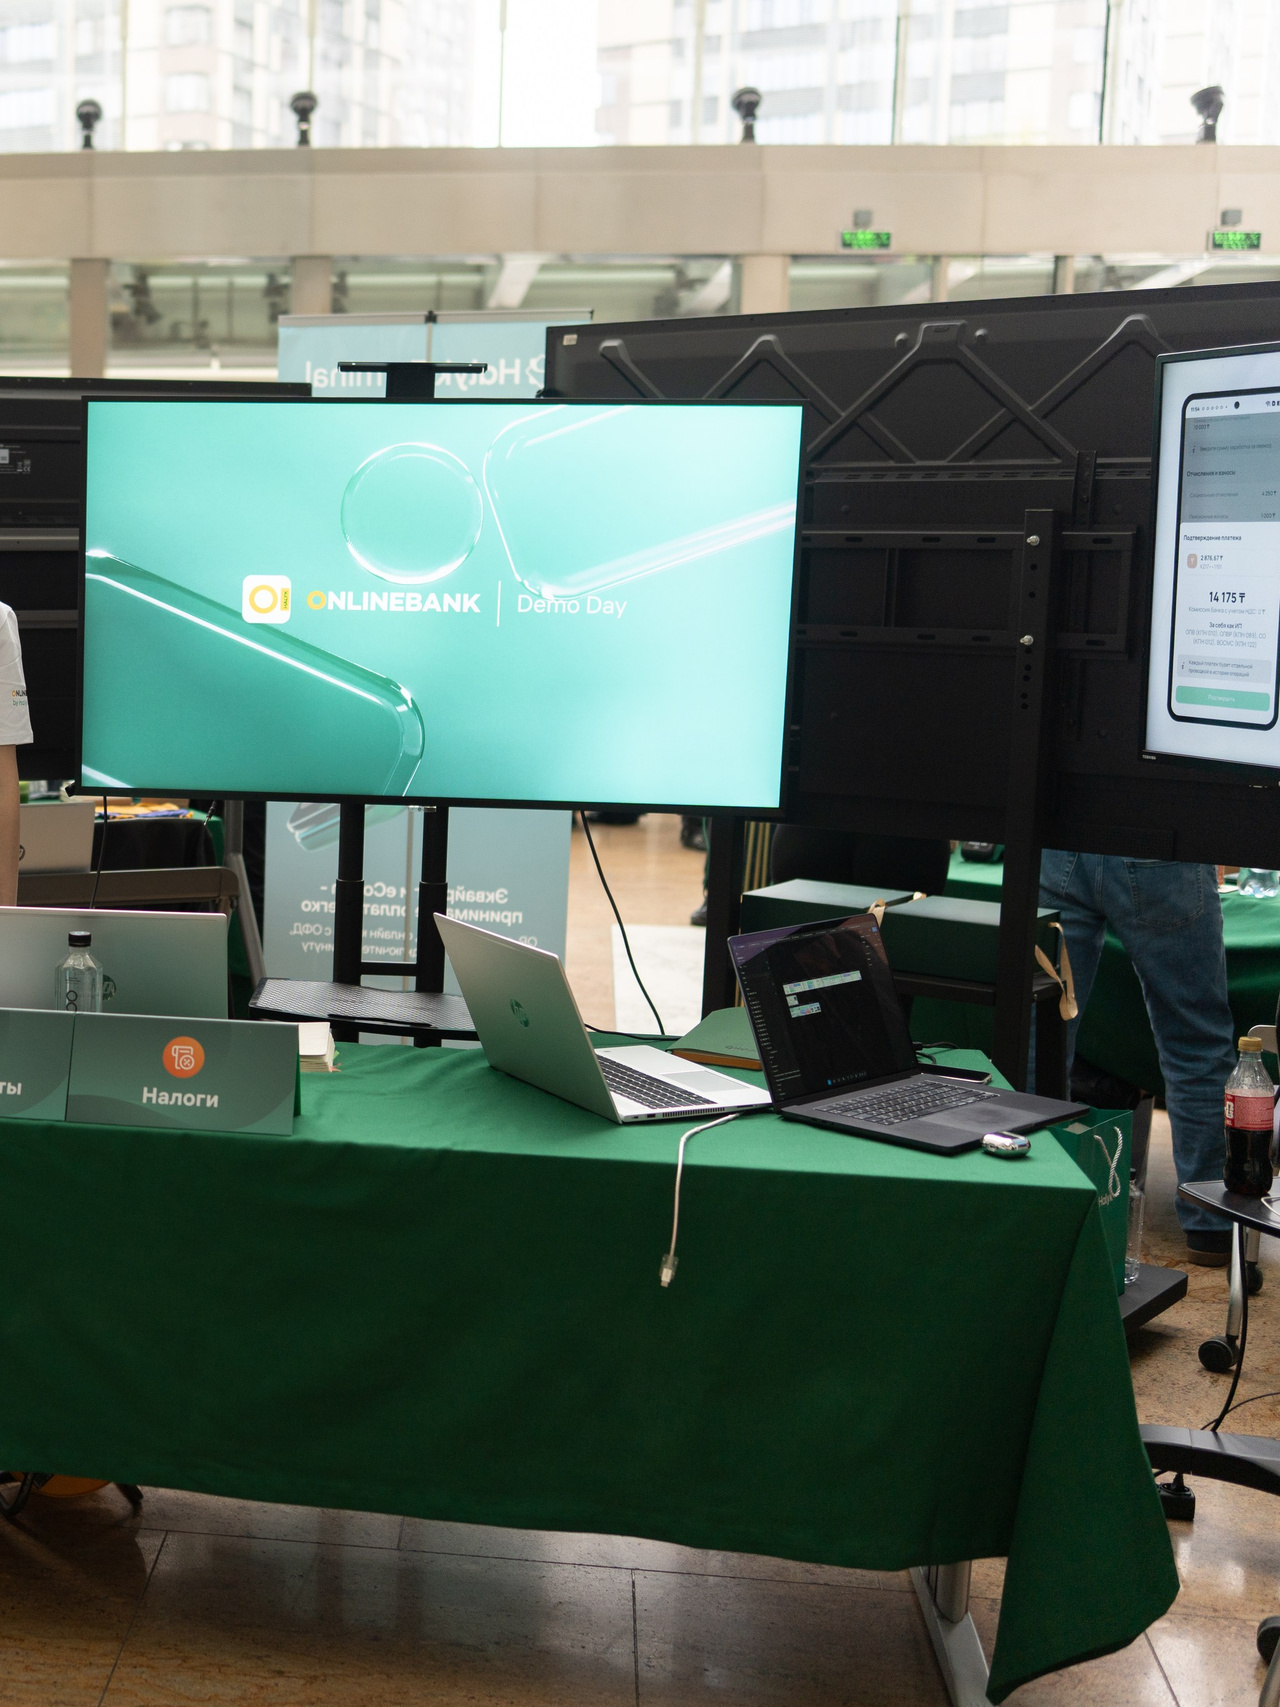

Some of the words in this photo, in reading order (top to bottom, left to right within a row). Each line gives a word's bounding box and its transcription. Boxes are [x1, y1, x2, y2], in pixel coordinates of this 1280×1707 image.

[307, 590, 481, 613] ONLINEBANK
[518, 594, 580, 614] Demo
[586, 595, 627, 619] Day
[1222, 591, 1237, 603] 175
[142, 1087, 219, 1108] Налоги
